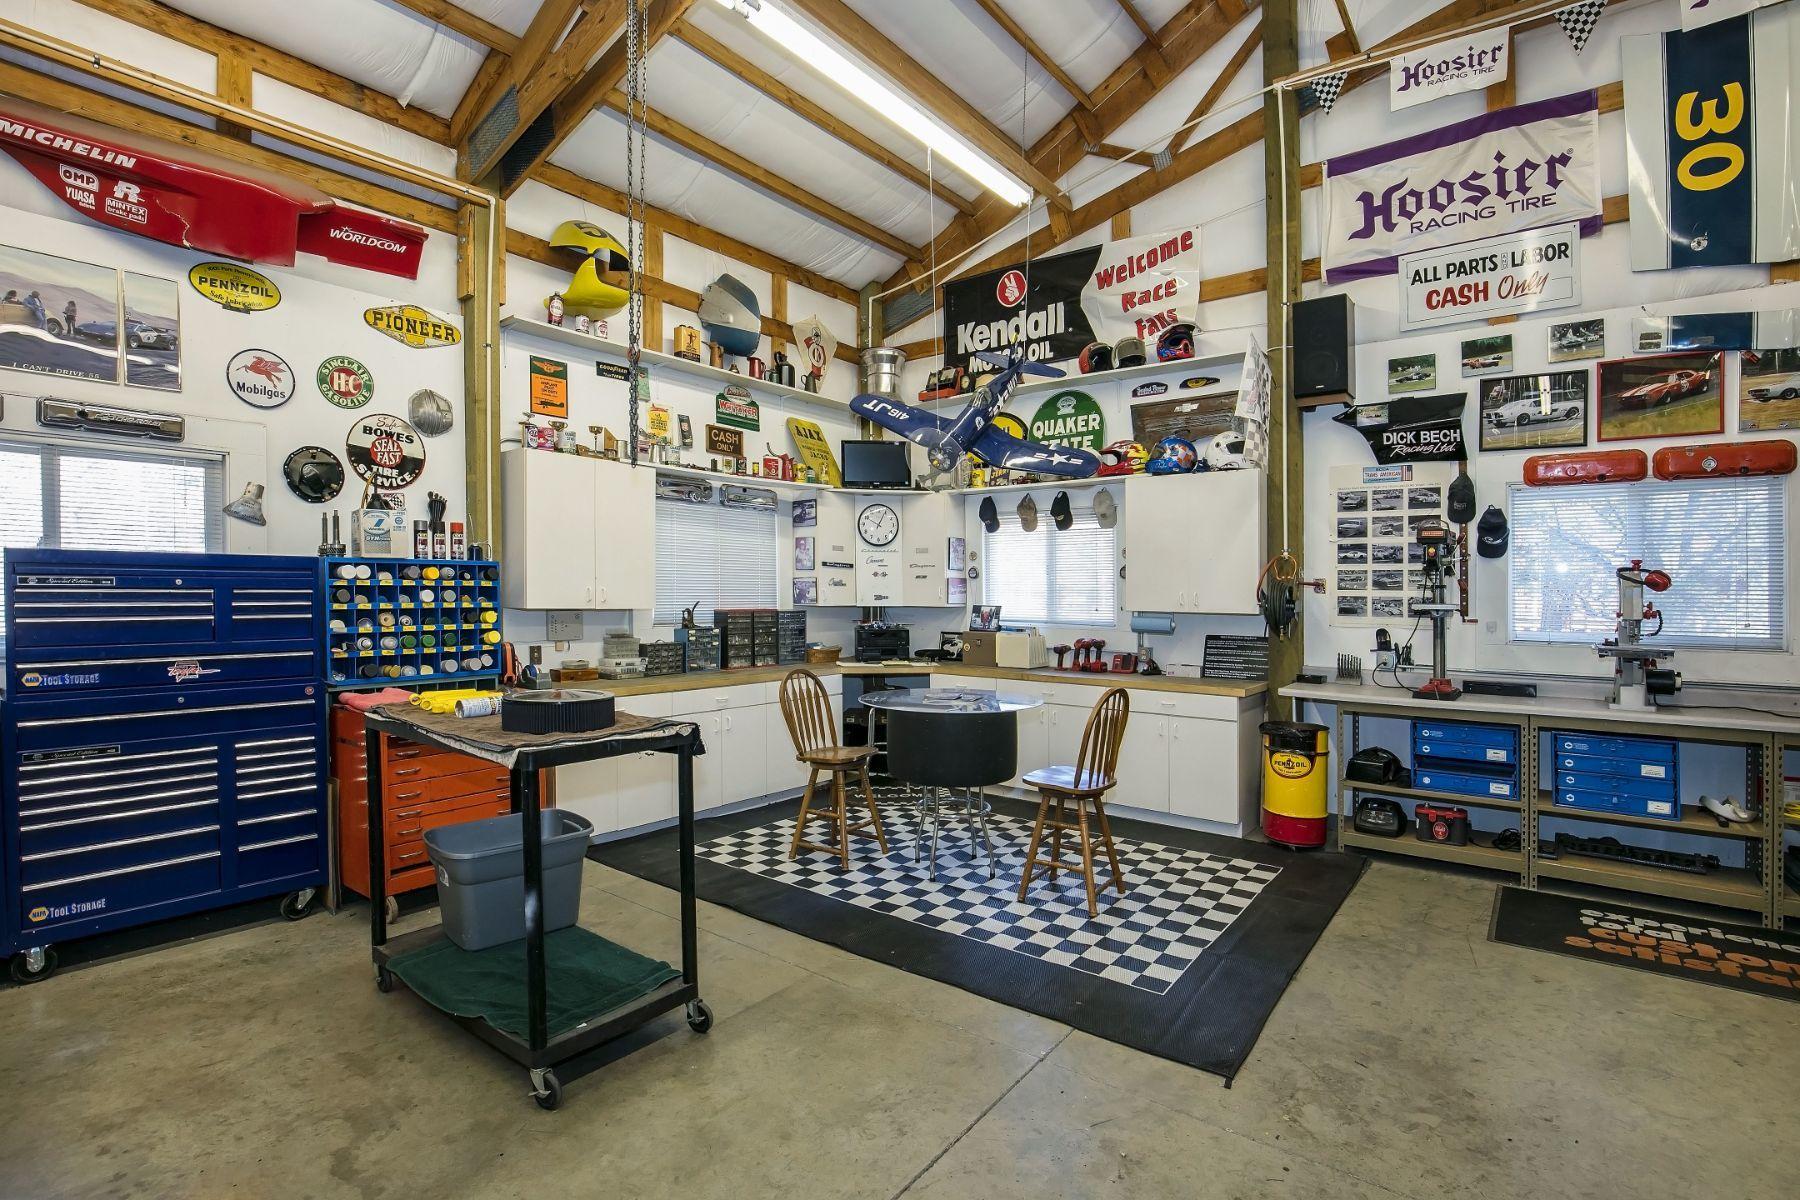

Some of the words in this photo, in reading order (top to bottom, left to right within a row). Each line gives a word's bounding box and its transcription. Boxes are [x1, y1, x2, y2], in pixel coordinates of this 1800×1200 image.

[1397, 43, 1504, 92] Hoosier
[1427, 71, 1468, 87] RACING
[1472, 65, 1496, 76] TIRE
[0, 120, 137, 169] MICHELIN
[1675, 81, 1745, 192] 30
[62, 169, 96, 187] OMP
[65, 186, 96, 206] YUASA
[1348, 150, 1573, 241] Hoosier
[107, 199, 145, 216] MINTEX
[1410, 206, 1496, 234] RACING
[1505, 192, 1557, 214] TIRE
[330, 228, 407, 254] WORLDCOM
[1095, 230, 1194, 291] Welcome
[1410, 265, 1441, 286] ALL
[1446, 254, 1498, 279] PARTS
[1511, 242, 1569, 268] LABOR
[198, 276, 274, 298] PENNZOIL
[209, 290, 225, 301] Safe
[1121, 278, 1178, 313] Race
[1425, 281, 1489, 311] CASH
[1498, 271, 1550, 299] Only
[372, 310, 456, 343] PIONEER
[957, 302, 1065, 355] Kendall
[1028, 340, 1054, 362] OIL
[56, 369, 84, 378] DRIVE
[321, 358, 370, 381] SINCLAIR
[236, 381, 286, 399] Mobilgas
[321, 383, 370, 407] GASOLINE
[362, 425, 414, 444] BOWES
[711, 429, 739, 444] CASH
[794, 425, 823, 442] AJAX
[1032, 414, 1101, 438] QUAKER
[1382, 431, 1417, 445] DICK
[1420, 429, 1461, 443] BECH
[374, 440, 400, 452] SEAL
[716, 443, 734, 453] ONLY
[1389, 443, 1435, 458] Racing
[377, 452, 401, 465] FAST
[371, 465, 399, 477] TIRE
[43, 675, 63, 686] TOOL
[64, 673, 100, 685] STORAGE
[1274, 760, 1306, 768] PENNZOIL
[50, 907, 70, 918] TOOL
[71, 898, 106, 914] STORAGE
[1580, 915, 1687, 942] total
